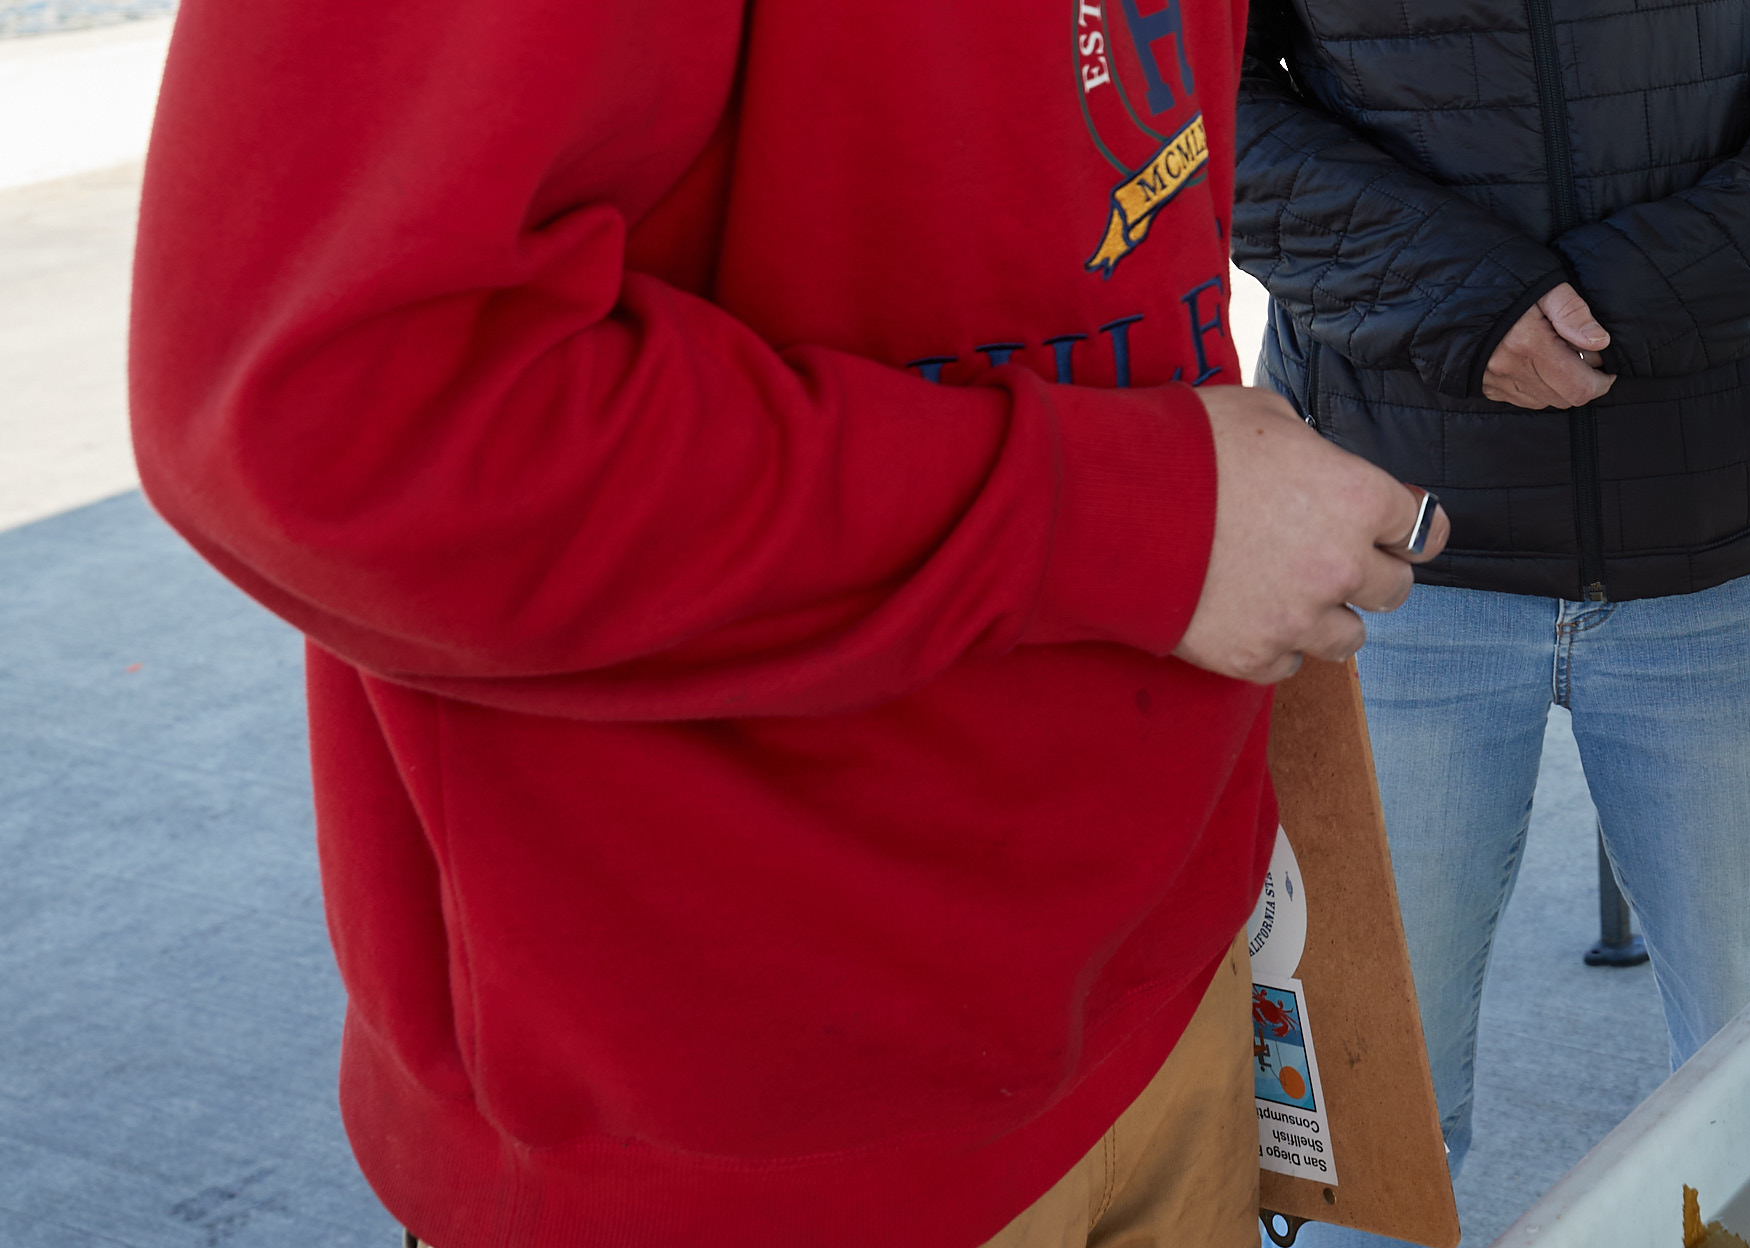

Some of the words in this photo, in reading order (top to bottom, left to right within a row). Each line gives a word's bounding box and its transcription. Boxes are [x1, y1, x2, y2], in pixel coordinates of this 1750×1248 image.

[1272, 1129, 1324, 1153] Shellfish
[1266, 1145, 1302, 1167] Diego
[1303, 1155, 1328, 1172] San
